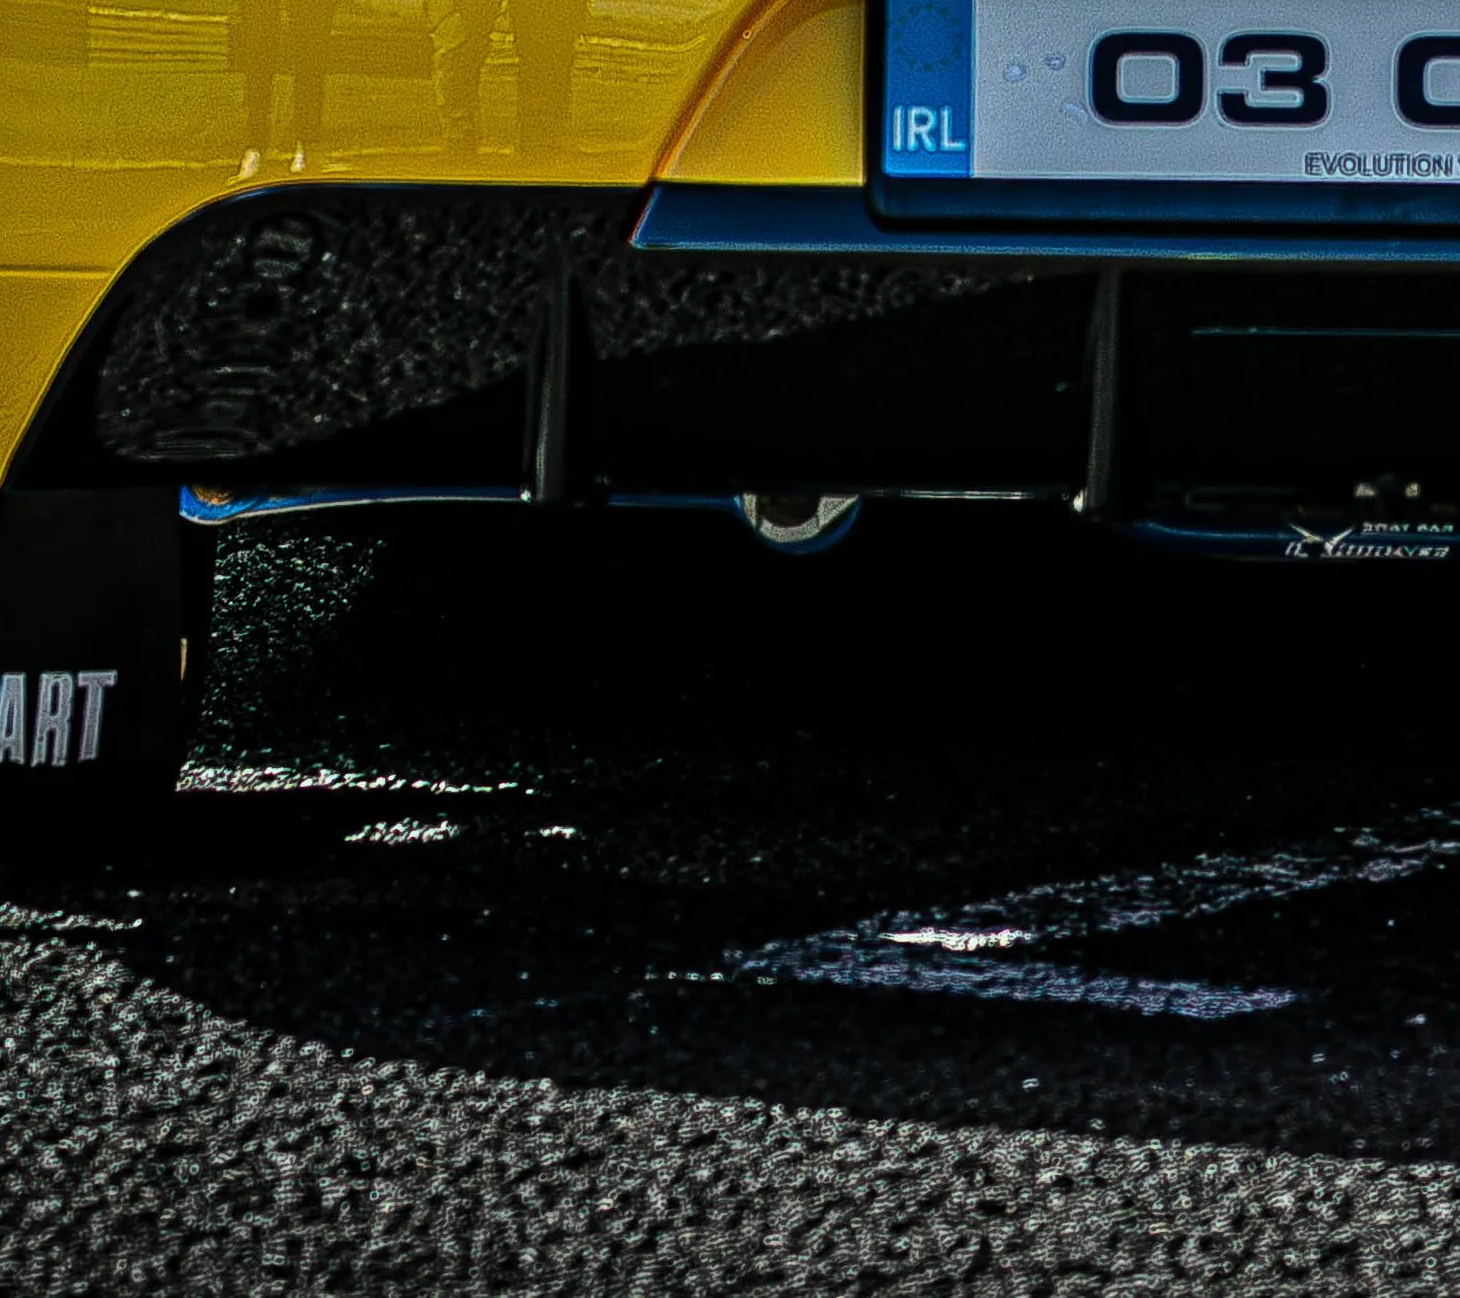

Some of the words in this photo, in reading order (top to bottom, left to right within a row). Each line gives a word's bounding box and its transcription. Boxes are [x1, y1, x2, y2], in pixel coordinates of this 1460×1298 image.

[1087, 30, 1329, 128] 03
[893, 106, 966, 152] IRL
[1304, 151, 1454, 177] EVOLUTION
